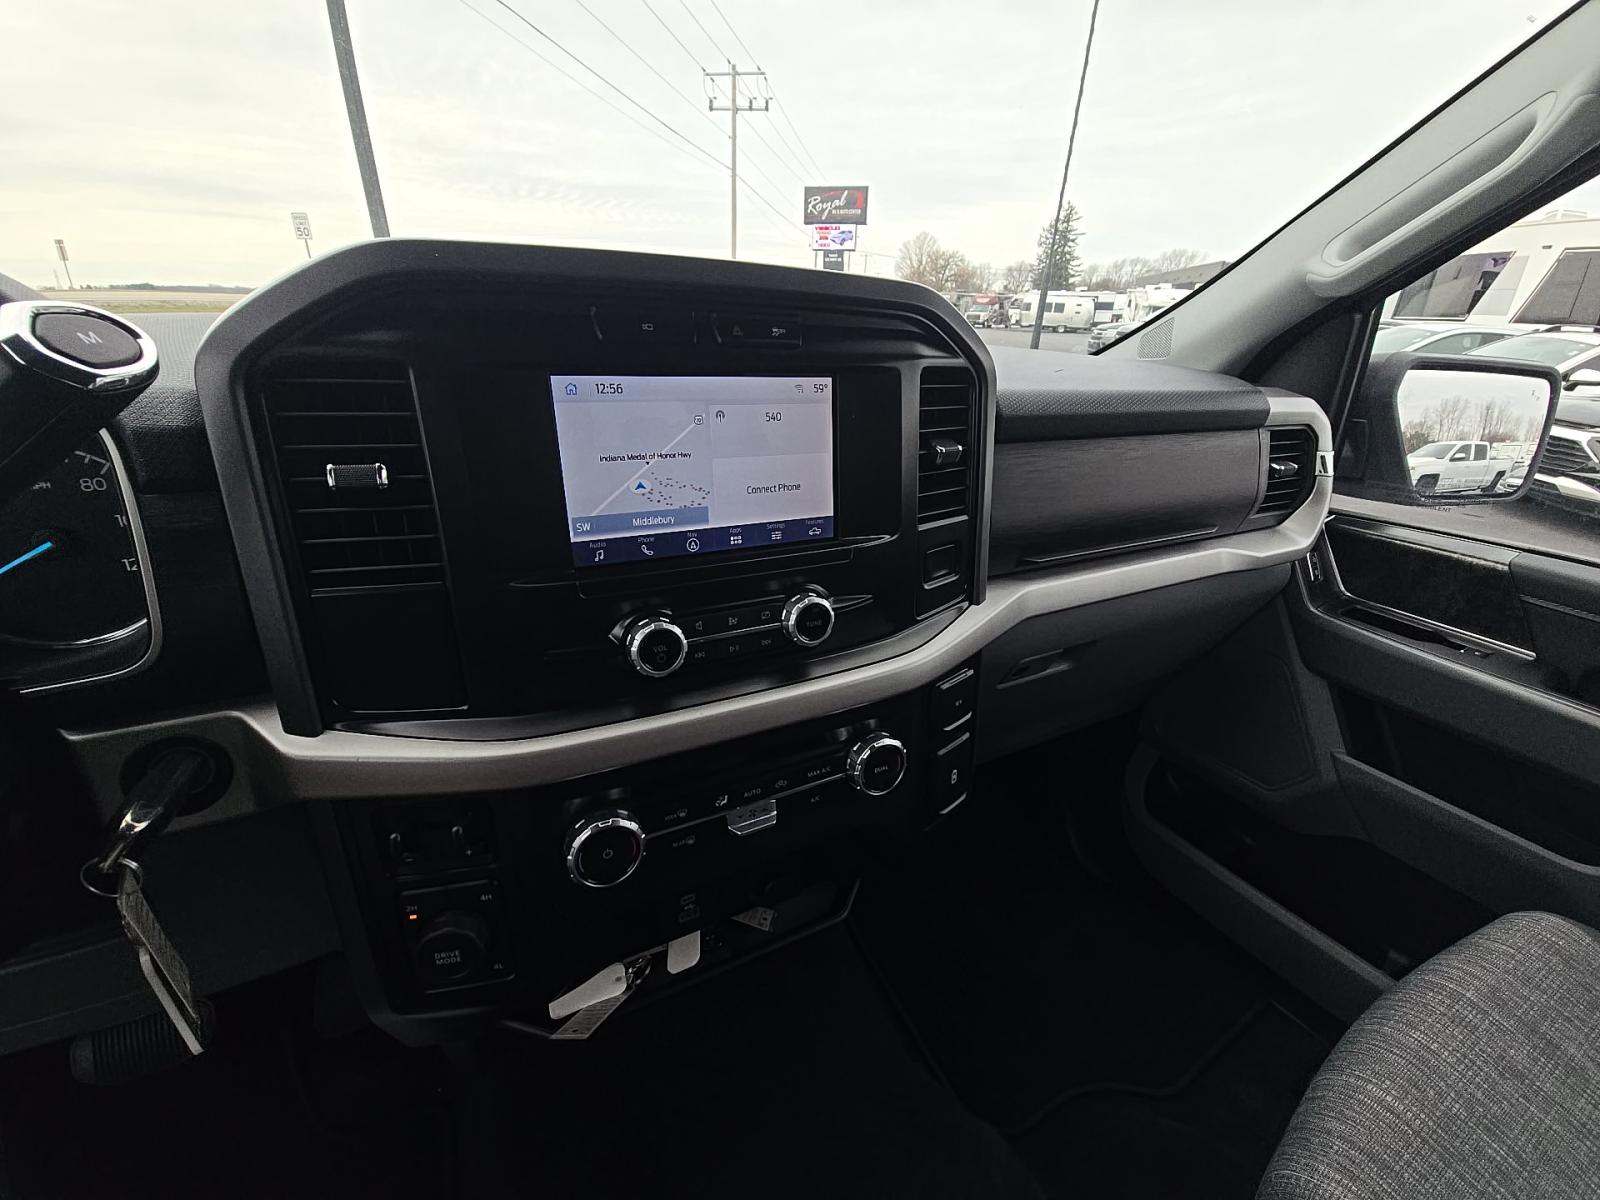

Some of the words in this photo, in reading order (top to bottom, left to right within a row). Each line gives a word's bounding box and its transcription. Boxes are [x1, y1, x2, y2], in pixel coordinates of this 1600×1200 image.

[807, 189, 848, 220] Royal
[297, 227, 310, 237] 50
[76, 331, 104, 344] M
[595, 383, 624, 395] 12:56
[813, 383, 829, 394] 59°
[765, 411, 782, 422] 540
[599, 454, 626, 463] Indiana
[626, 453, 648, 462] Medal
[648, 452, 656, 460] of
[656, 452, 677, 460] Honor
[677, 451, 692, 460] Hwy
[79, 478, 107, 492] 80
[746, 483, 777, 495] Connect
[778, 481, 801, 493] Phone
[576, 522, 591, 532] SW
[632, 515, 675, 528] Middlebury
[589, 541, 607, 549] Audio
[653, 644, 669, 653] VOL
[874, 765, 889, 774] DUAL
[743, 788, 761, 799] AUTO
[479, 893, 493, 902] 4H
[434, 950, 460, 960] DRIVE
[435, 957, 462, 966] MODE
